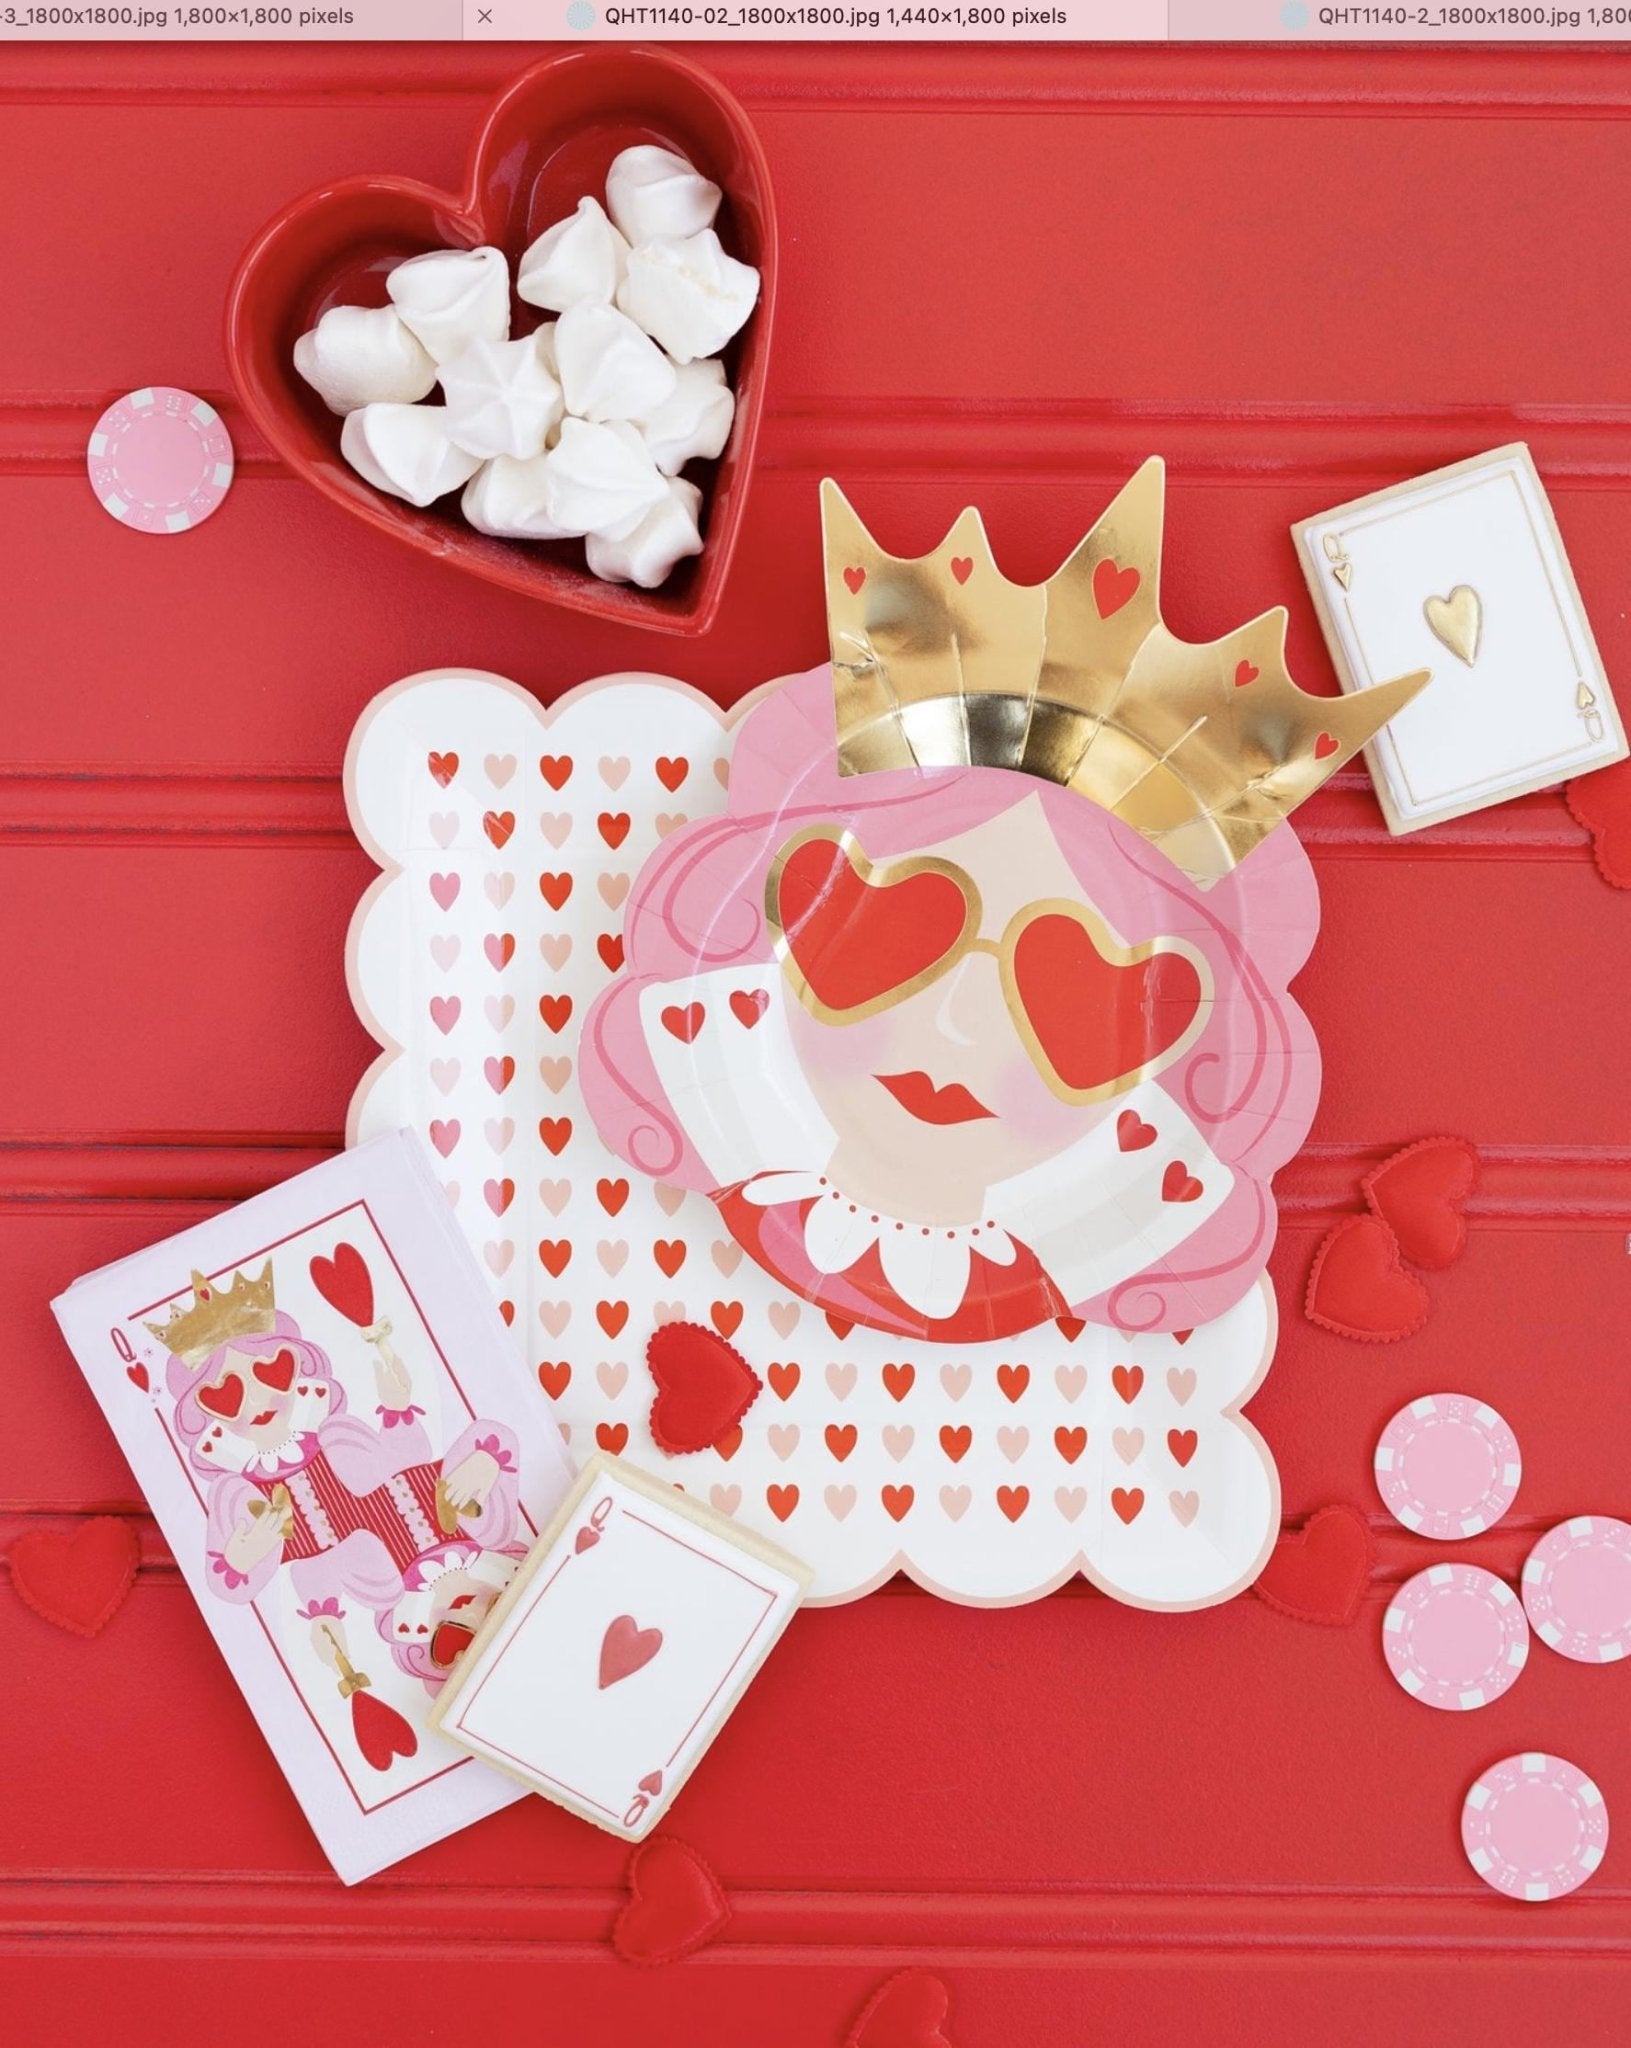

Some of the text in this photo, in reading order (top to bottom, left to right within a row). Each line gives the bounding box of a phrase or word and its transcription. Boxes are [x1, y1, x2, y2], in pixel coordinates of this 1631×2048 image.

[111, 1327, 137, 1362] Q
[591, 1496, 613, 1532] Q
[624, 1794, 649, 1828] Q
